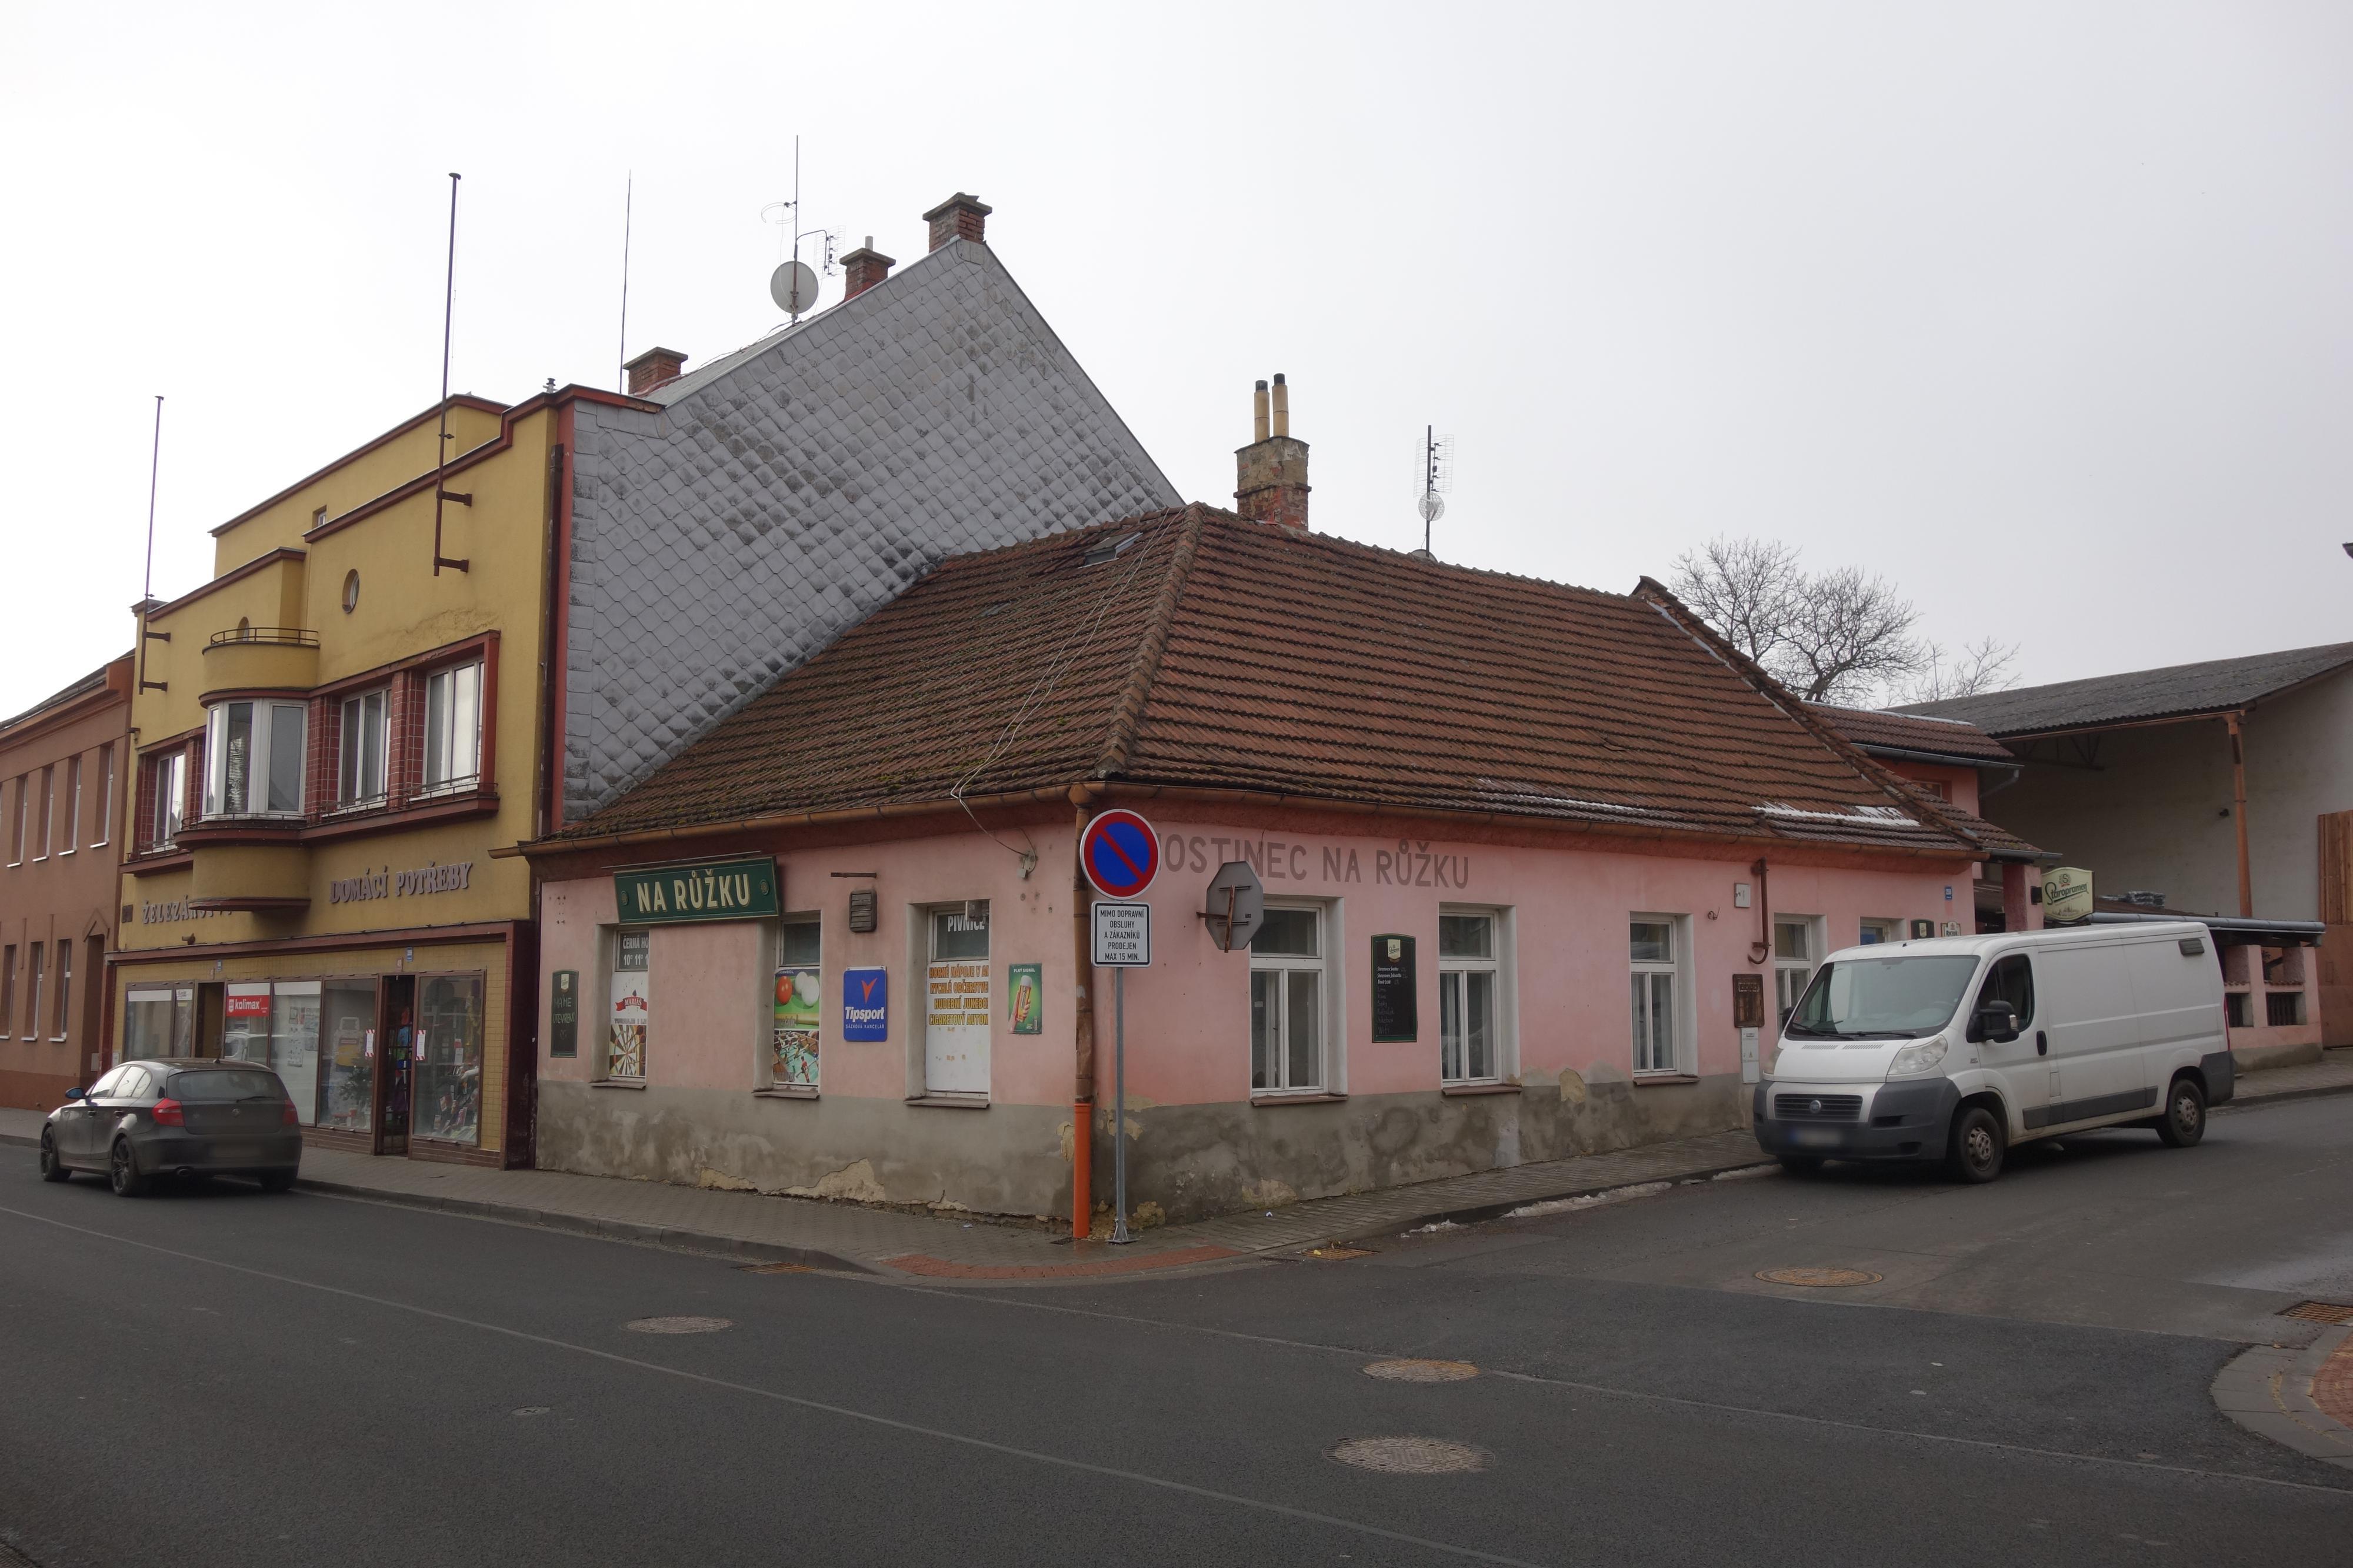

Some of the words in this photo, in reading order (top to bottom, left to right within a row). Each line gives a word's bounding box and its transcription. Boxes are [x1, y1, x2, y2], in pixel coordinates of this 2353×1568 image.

[1158, 833, 1308, 881] OSTINEC
[1322, 846, 1362, 883] NA
[1375, 838, 1469, 890] RŮŽKU
[329, 866, 388, 903] DOMÁCÍ
[395, 860, 473, 897] POTŘEBY
[636, 882, 667, 913] NA
[673, 869, 751, 911] RŮŽKU
[2045, 882, 2089, 905] Staropramen
[142, 895, 233, 925] ŽELEZÁ
[1117, 909, 1144, 918] DOPRAVNÍ
[1109, 929, 1140, 939] ZÁKAZNÍKŮ
[622, 935, 640, 949] ČERNÁ
[1108, 942, 1136, 950] PRODEJEN
[929, 964, 949, 979] HORKÉ
[951, 963, 975, 978] NÁPOJE
[976, 966, 981, 977] V
[930, 979, 952, 994] RYCHLÉ
[954, 979, 989, 993] OBČERSTVE
[235, 998, 259, 1010] kolimax
[934, 995, 962, 1010] HUDEBNÍ
[845, 1006, 884, 1022] Tipsport
[929, 1011, 965, 1025] CIGARETOVÝ
